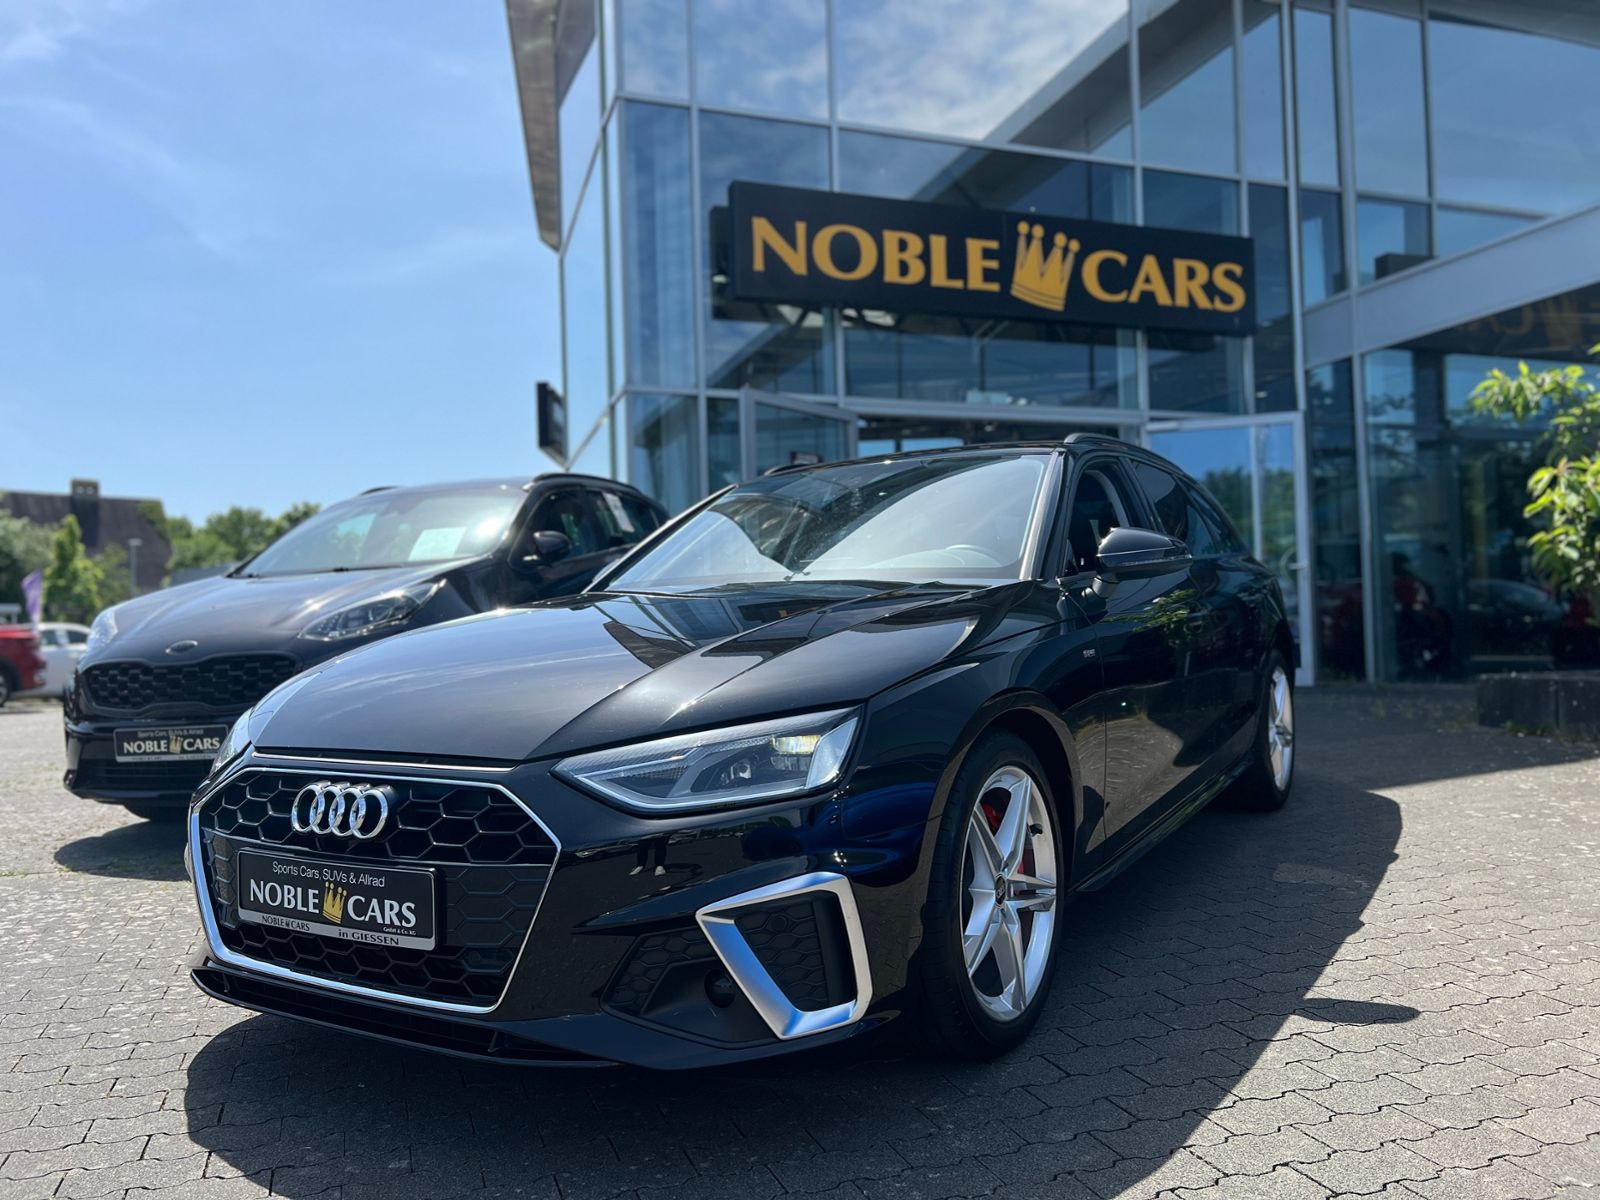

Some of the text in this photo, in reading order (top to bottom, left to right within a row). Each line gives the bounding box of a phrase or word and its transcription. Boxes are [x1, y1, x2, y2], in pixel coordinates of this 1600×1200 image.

[751, 216, 1247, 313] NOBLE CARS
[123, 738, 220, 754] NOBLE CARS
[272, 861, 299, 875] Sports
[322, 868, 348, 883] SUVs
[349, 872, 357, 885] &
[358, 873, 386, 888] Allrad
[250, 879, 416, 928] NOBLE CARS
[262, 915, 310, 931] NOBLE CARS
[338, 929, 399, 945] in GIESSEN
